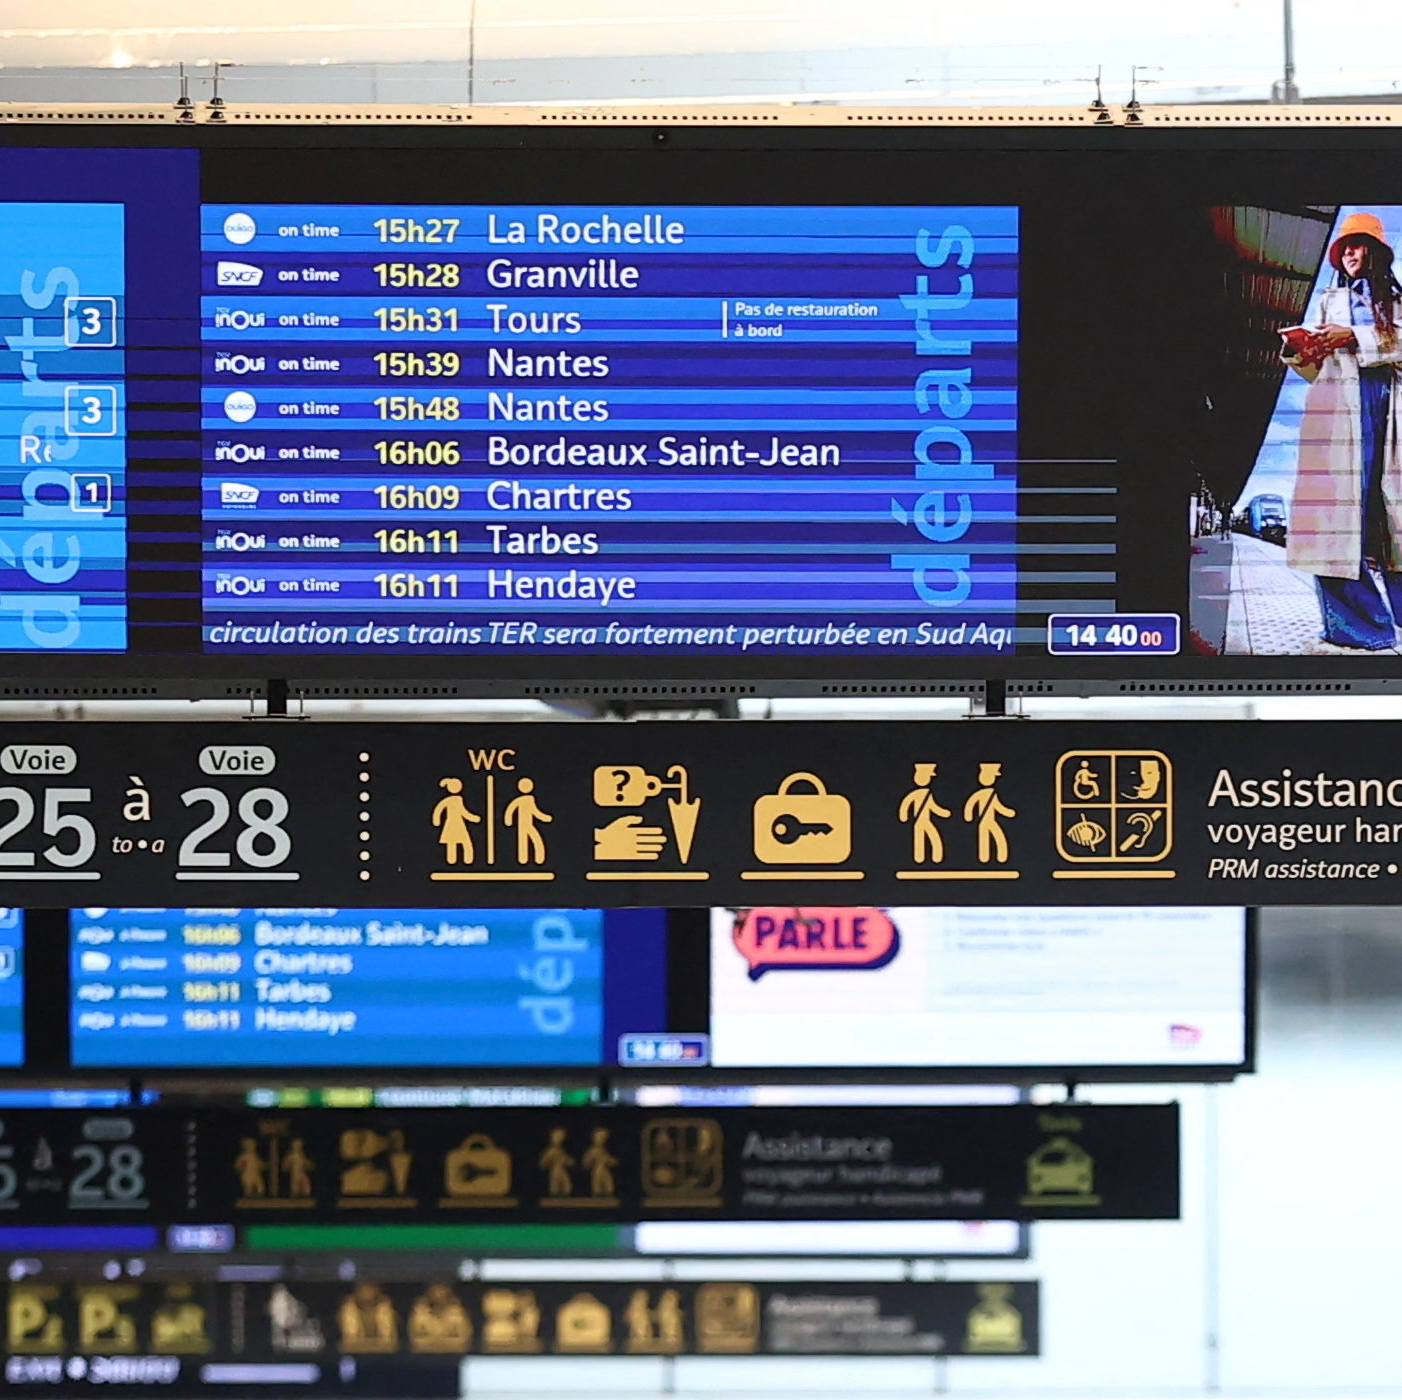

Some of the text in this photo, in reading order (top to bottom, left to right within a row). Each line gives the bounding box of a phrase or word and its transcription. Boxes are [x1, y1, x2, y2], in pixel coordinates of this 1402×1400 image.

[374, 215, 683, 243] 15h27 La Rochelle
[221, 271, 259, 282] SNCF
[279, 259, 638, 287] on time 15h28 Granville
[83, 308, 100, 334] 3
[375, 305, 580, 333] 15h31 Tours
[736, 303, 877, 315] Pas de restauration
[735, 325, 781, 336] à bord
[374, 349, 608, 376] 15h39 Nantes
[83, 397, 101, 423] 3
[374, 393, 608, 421] 15h48 Nantes
[890, 224, 994, 607] départs
[0, 267, 103, 648] départs
[375, 437, 839, 465] 16h06 Bordeaux Saint-Jean
[86, 483, 97, 502] 1
[374, 481, 631, 509] 16h09 Chartres
[375, 526, 598, 554] 16h11 Tarbes
[374, 570, 635, 605] 16h11 Hendaye
[211, 621, 966, 650] circulation des trains TER sera fortement perturbée en Sud
[1067, 625, 1161, 645] 14 40 00
[8, 749, 65, 773] Voie
[209, 750, 264, 771] Voie
[469, 750, 515, 770] WC
[124, 776, 150, 820] à
[179, 788, 290, 867] 28
[113, 837, 164, 852] to a
[1208, 825, 1346, 850] voyageur
[1209, 859, 1259, 878] PRM
[1265, 859, 1380, 878] assistance
[756, 916, 870, 950] PARLE
[256, 1008, 356, 1034] Hendaye
[71, 1147, 142, 1202] 28
